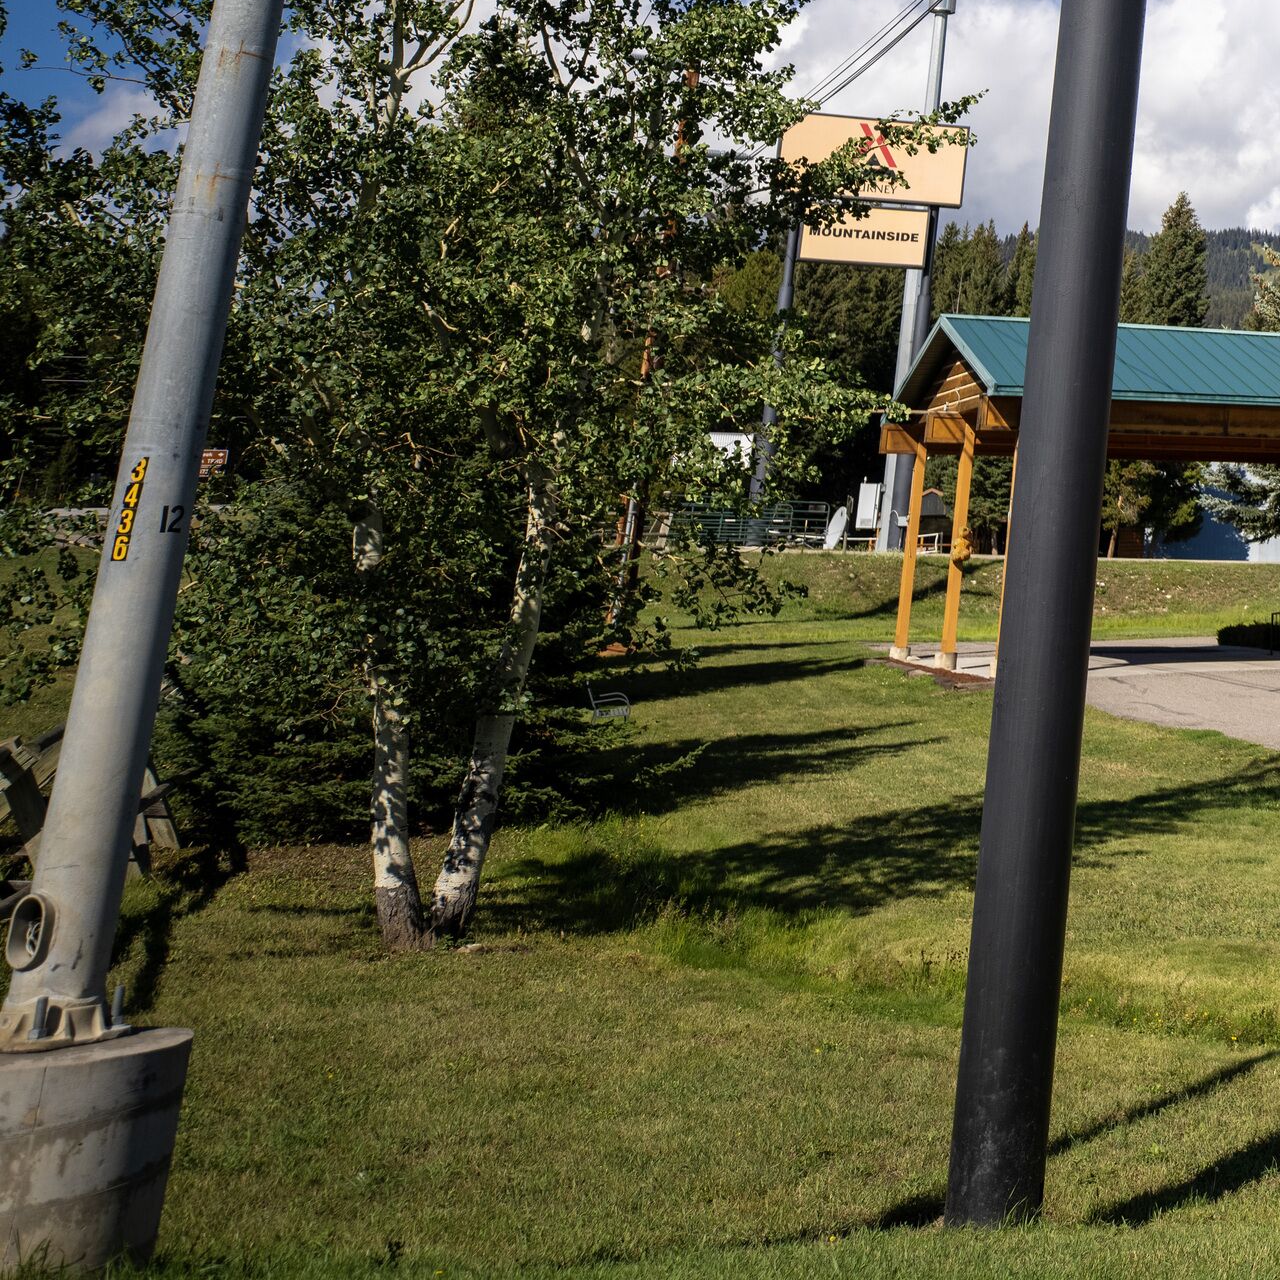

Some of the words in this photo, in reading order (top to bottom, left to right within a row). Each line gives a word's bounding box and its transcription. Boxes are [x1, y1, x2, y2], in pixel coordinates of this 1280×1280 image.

[809, 226, 919, 243] MOUNTAINSIDE
[112, 458, 147, 561] 3436
[159, 504, 185, 534] 12
